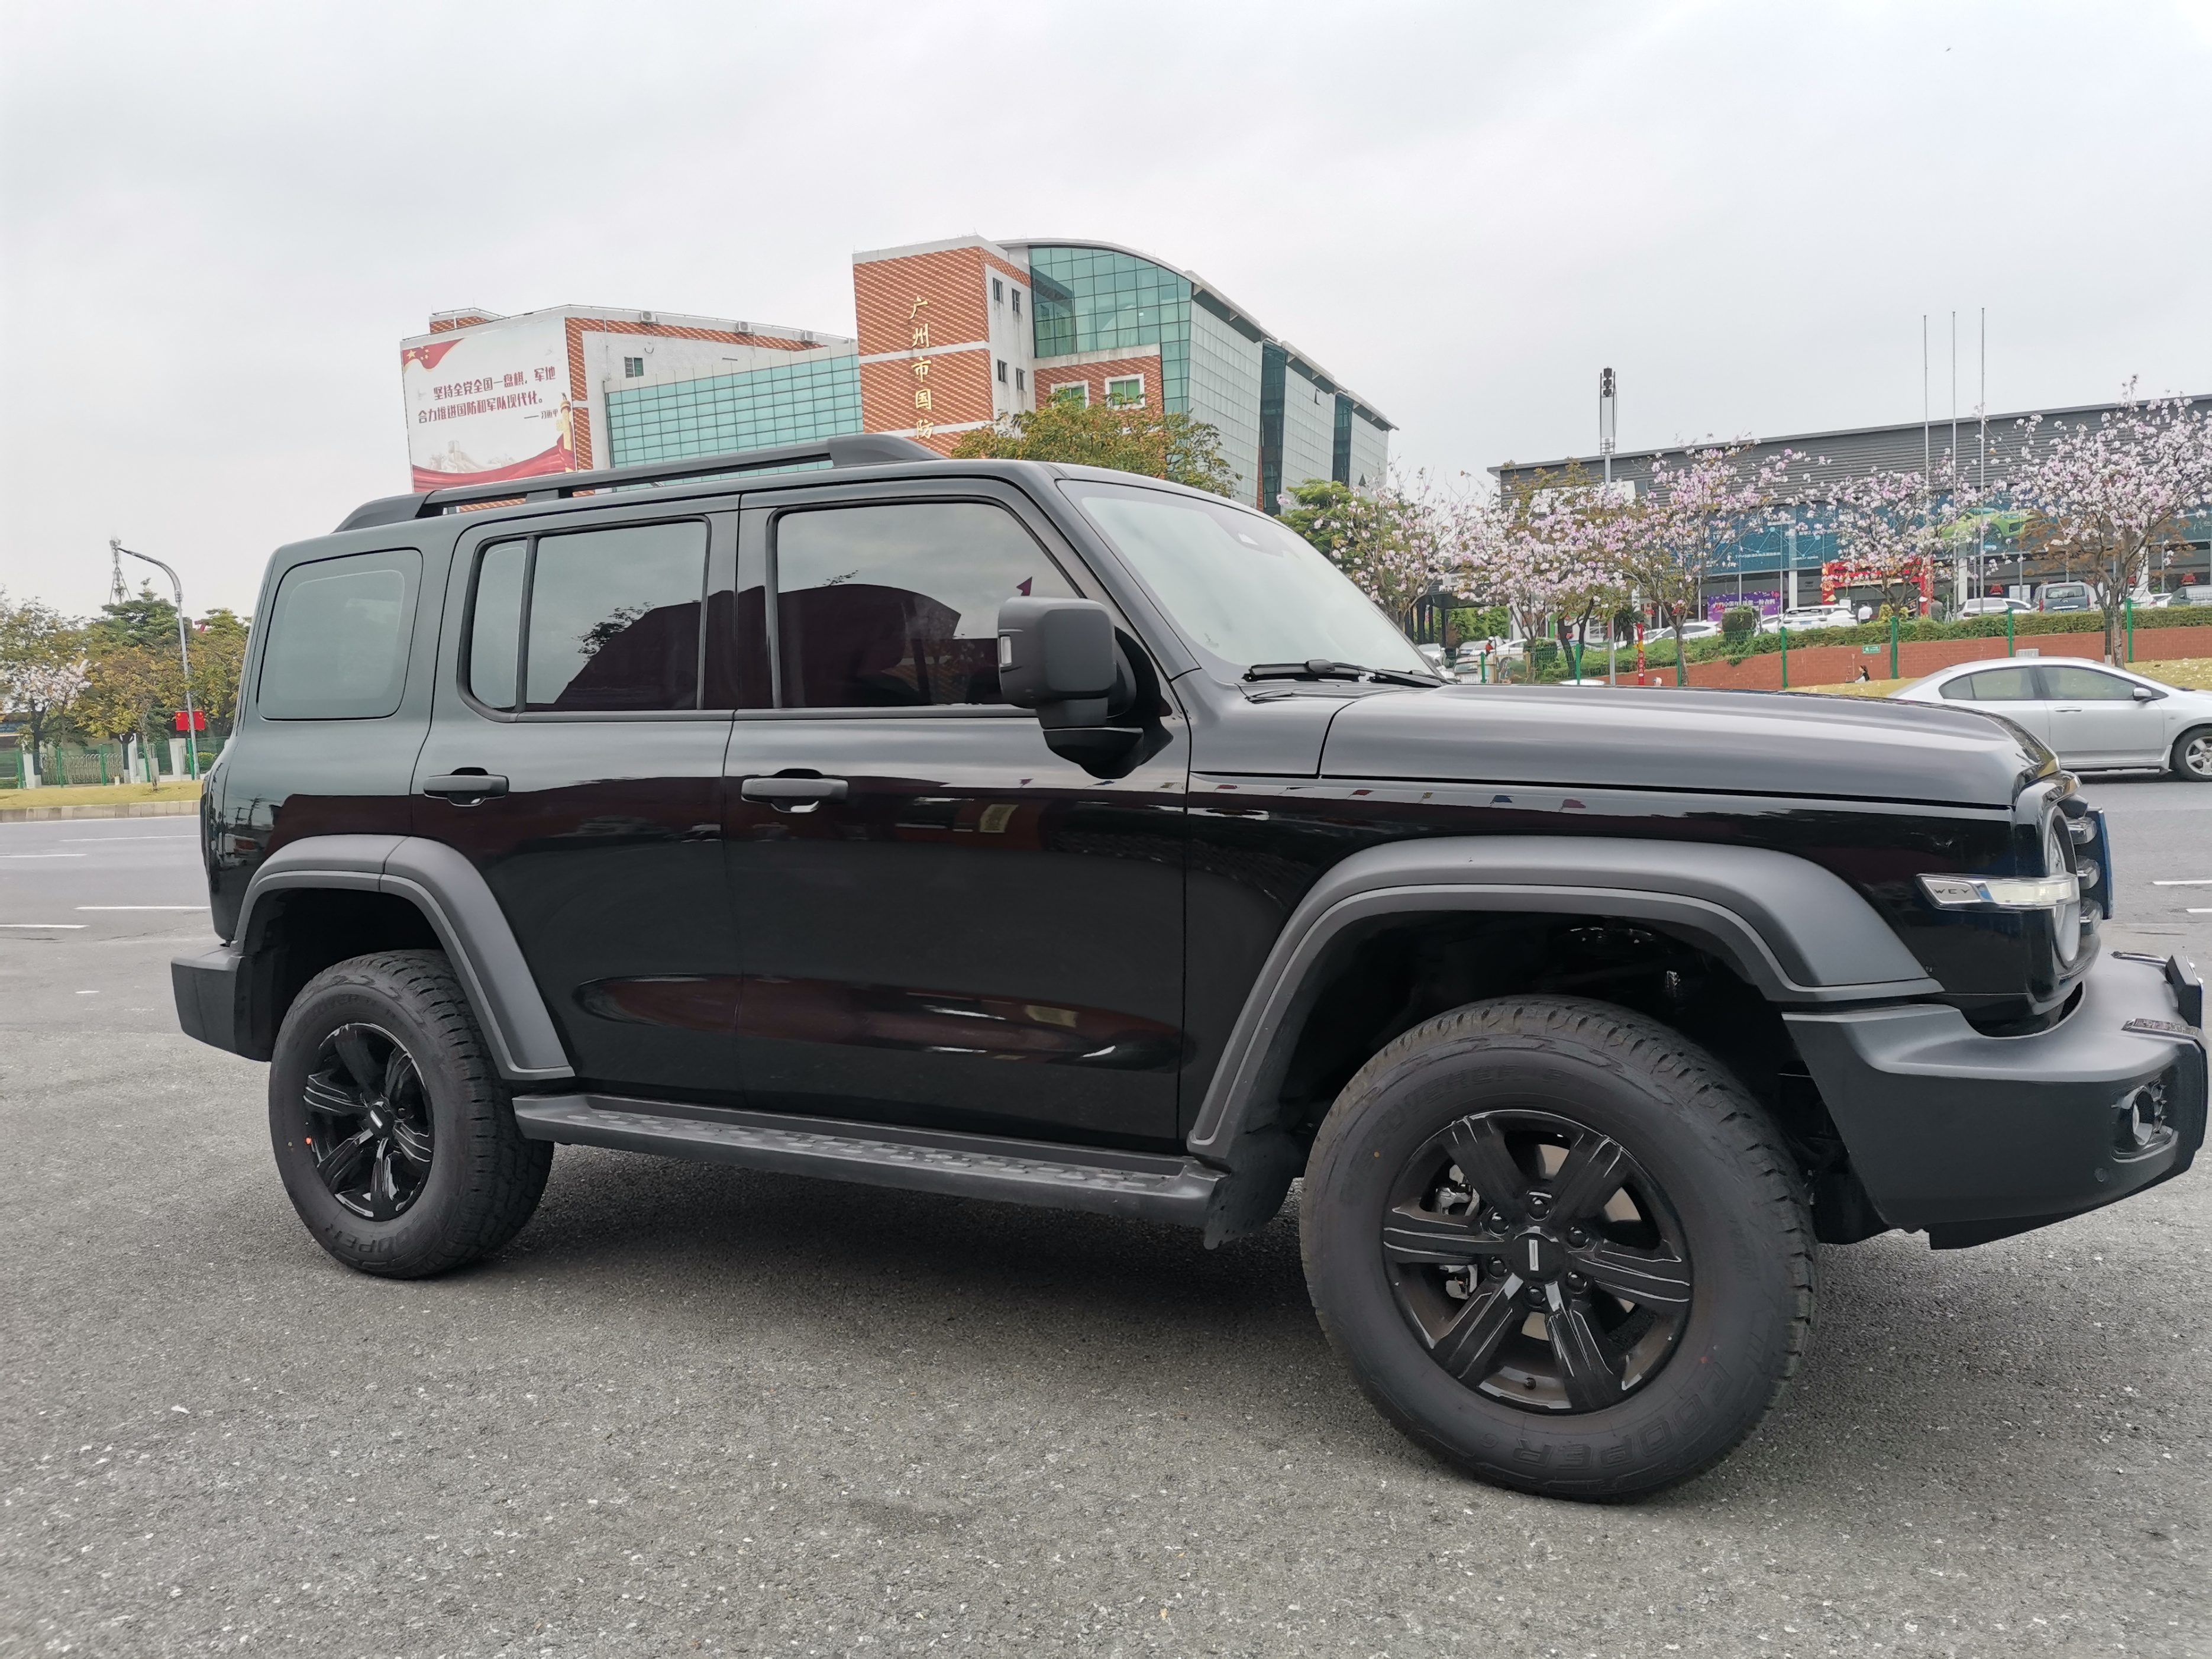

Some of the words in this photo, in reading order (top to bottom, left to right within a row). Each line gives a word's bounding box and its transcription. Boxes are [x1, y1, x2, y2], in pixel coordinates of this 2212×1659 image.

[907, 295, 934, 440] 广州市国防
[1511, 1361, 1735, 1471] COOPER
